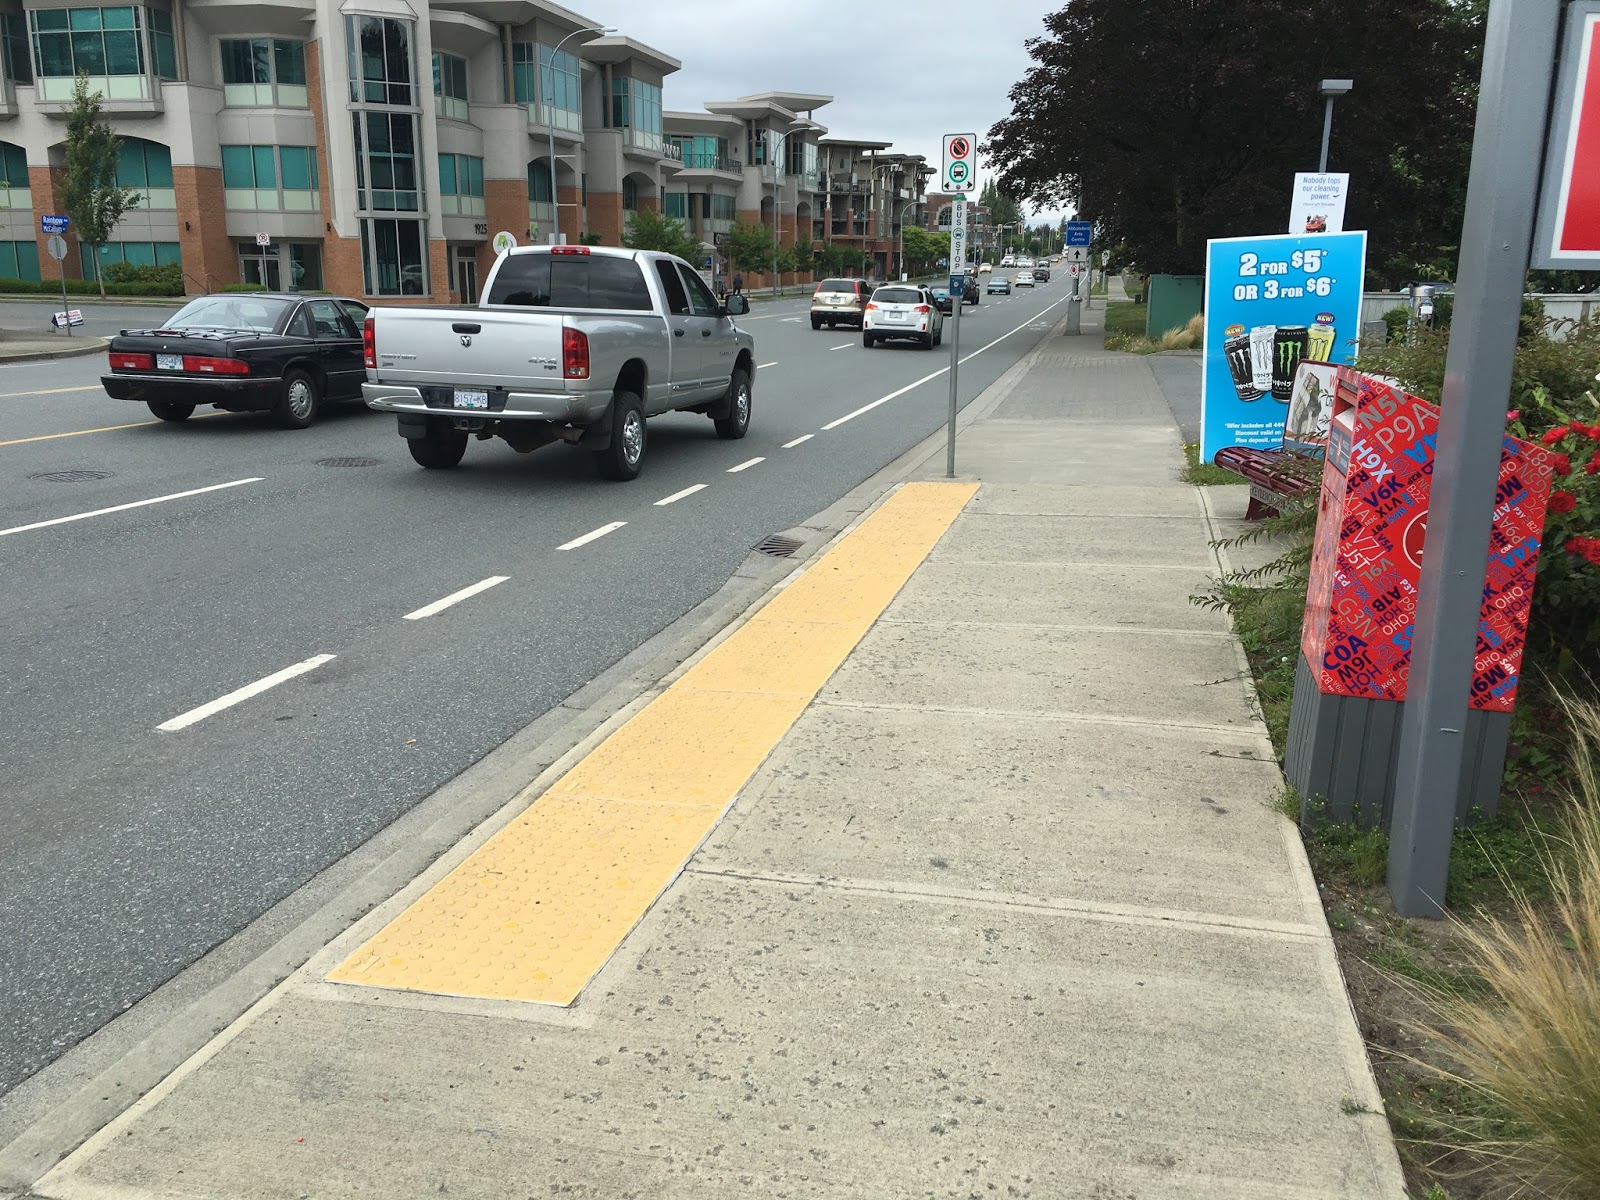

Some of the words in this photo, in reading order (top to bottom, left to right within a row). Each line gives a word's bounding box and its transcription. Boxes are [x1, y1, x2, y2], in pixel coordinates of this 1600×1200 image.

[1303, 176, 1326, 184] Nobody
[1314, 185, 1339, 193] cleaning
[43, 216, 63, 224] Rainbow
[474, 223, 488, 235] 1925
[1239, 252, 1258, 276] 2
[1260, 262, 1288, 275] FOR
[1233, 284, 1258, 301] OR
[1263, 279, 1279, 299] 3
[1280, 287, 1304, 298] FOR
[1375, 403, 1440, 454] P9A
[1351, 438, 1394, 484] H9X
[1362, 475, 1405, 507] V6K
[1375, 497, 1403, 518] V1X
[1500, 516, 1527, 545] P9A
[1353, 527, 1386, 562] V7J
[1499, 536, 1540, 568] K4A
[1343, 549, 1371, 570] J5T
[1371, 585, 1401, 612] A1B
[1399, 578, 1417, 595] P3Y
[1337, 598, 1379, 638] G3N
[1488, 612, 1517, 640] R7N
[1497, 636, 1524, 655] V5A
[1337, 650, 1372, 683] J6W
[1499, 658, 1517, 675] S4N
